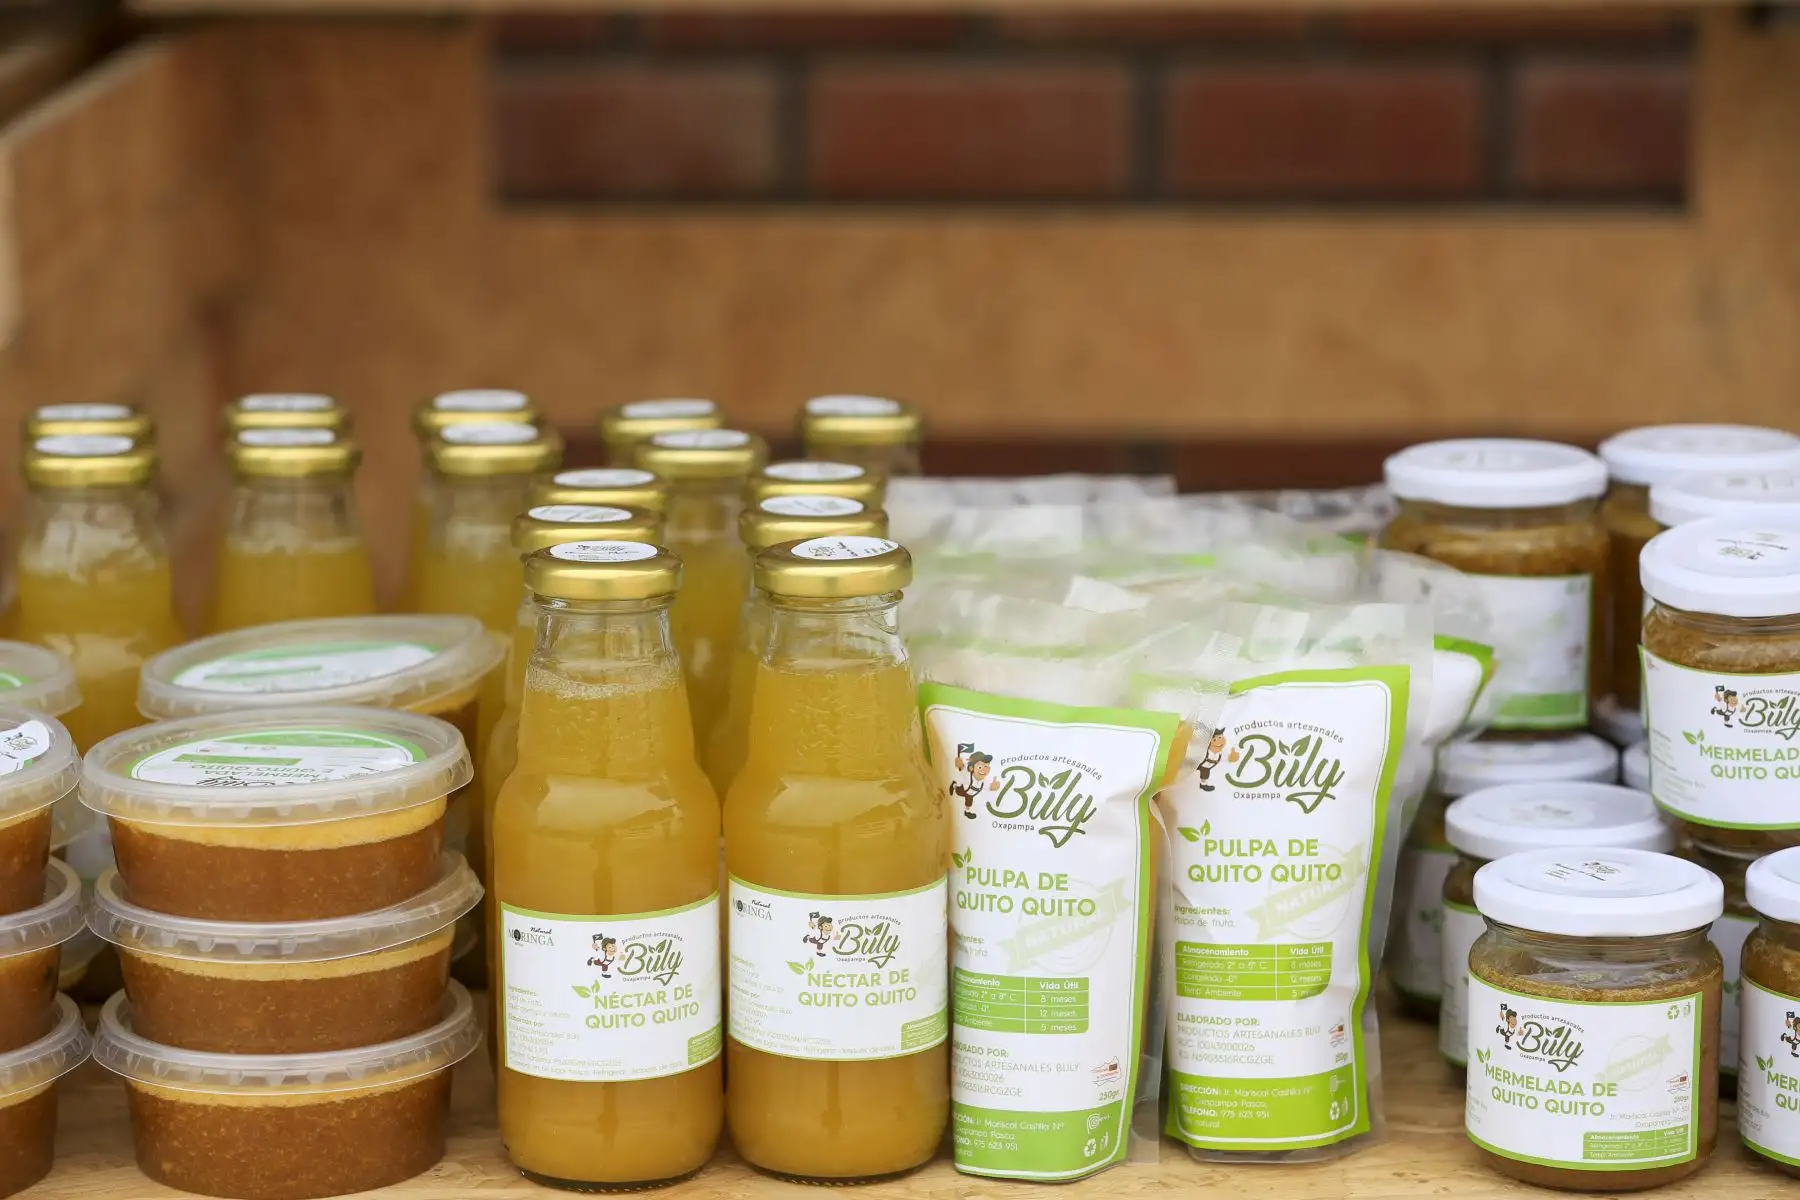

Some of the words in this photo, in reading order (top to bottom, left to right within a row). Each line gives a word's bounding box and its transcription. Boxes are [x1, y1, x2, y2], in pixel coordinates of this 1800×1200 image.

[1234, 719, 1283, 735] productos
[1287, 721, 1345, 745] artesanales
[204, 770, 320, 780] MERMELADA
[999, 753, 1050, 767] productos
[1052, 754, 1103, 782] artesanales
[1225, 734, 1345, 814] Buly
[1710, 764, 1767, 780] QUITO
[1233, 792, 1281, 801] Oxapampa
[985, 765, 1097, 849] Buly
[991, 820, 1036, 832] Oxapampa
[1204, 838, 1278, 858] PULPA
[1287, 838, 1319, 857] DE
[965, 865, 1030, 890] PULPA
[1038, 872, 1069, 892] DE
[1187, 863, 1262, 884] QUITO
[1270, 862, 1342, 883] QUITO
[956, 890, 1014, 914] QUITO
[1021, 895, 1096, 918] QUITO
[837, 913, 869, 925] productos
[871, 913, 902, 926] artesanales
[621, 932, 652, 945] productos
[653, 931, 684, 942] artesanales
[832, 921, 901, 969] Buly
[1183, 945, 1249, 957] Almacenamiento
[1290, 948, 1309, 956] Vida
[617, 939, 684, 986] Buly
[807, 970, 882, 988] NÉCTAR
[888, 967, 910, 985] DE
[1039, 981, 1061, 991] Vida
[593, 986, 668, 1010] NÉCTAR
[673, 983, 694, 1001] DE
[798, 991, 859, 1008] QUITO
[865, 985, 917, 1007] QUITO
[1050, 996, 1077, 1004] meses
[585, 1012, 646, 1030] QUITO
[651, 1001, 700, 1025] QUITO
[1039, 1009, 1047, 1018] 12
[1050, 1010, 1077, 1018] meses
[1177, 1012, 1232, 1026] ELABORADO
[1520, 1012, 1549, 1021] productos
[1550, 1015, 1585, 1034] artesanales
[1050, 1024, 1077, 1032] meses
[1177, 1024, 1229, 1038] PRODUCTOS
[1233, 1026, 1302, 1040] ARTESANALES
[1516, 1021, 1584, 1073] Buly
[984, 1059, 1052, 1073] ARTESANALES
[1056, 1063, 1080, 1073] BULY
[1485, 1062, 1585, 1096] MERMELADA
[1592, 1082, 1618, 1098] DE
[1767, 1070, 1800, 1092] MER
[1234, 1088, 1269, 1098] Mariscal
[1491, 1085, 1539, 1111] QUITO
[1544, 1098, 1605, 1118] QUITO
[1775, 1093, 1800, 1111] QU
[984, 1118, 1017, 1130] Mariscal
[1020, 1120, 1050, 1131] Castillo
